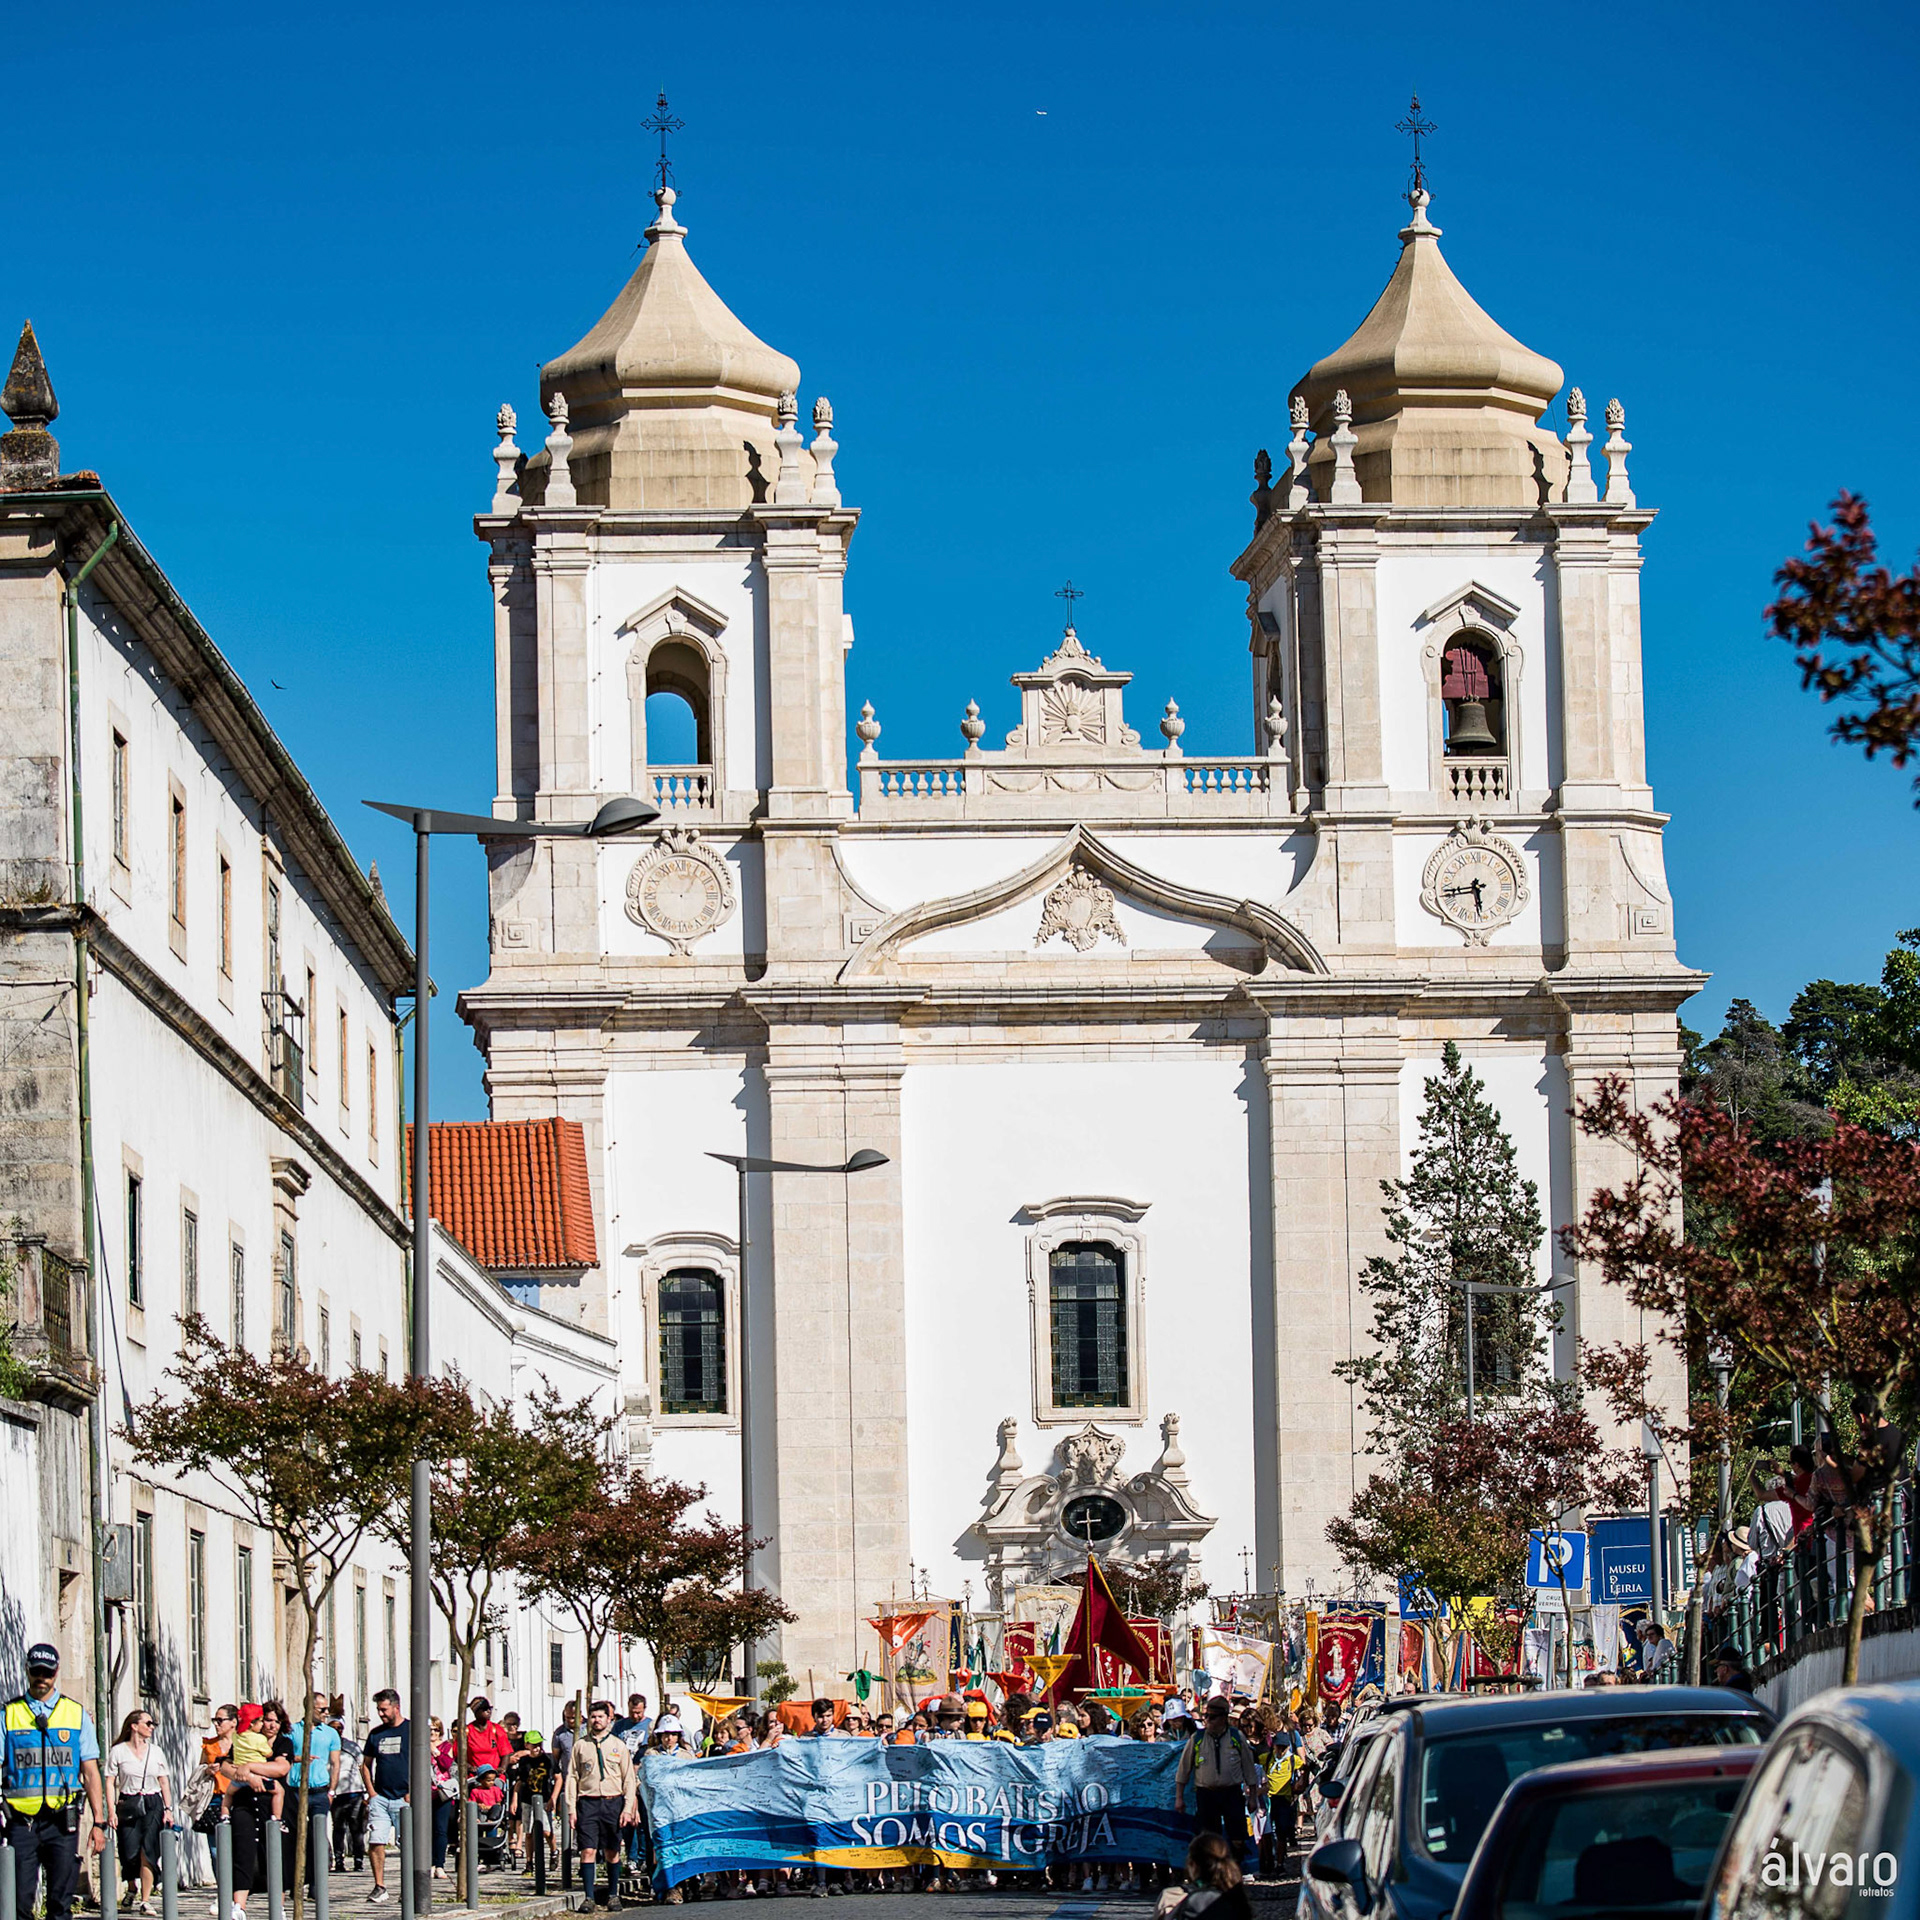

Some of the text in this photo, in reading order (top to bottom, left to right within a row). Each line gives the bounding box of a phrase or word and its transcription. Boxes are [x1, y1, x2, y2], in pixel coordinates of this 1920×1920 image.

[1538, 1536, 1573, 1583] P
[1609, 1563, 1646, 1574] MUSEU
[1610, 1583, 1643, 1594] LEIRIA
[30, 1650, 57, 1661] POLÍCIA
[16, 1747, 73, 1768] POLÍCIA
[866, 1780, 954, 1815] PELO
[851, 1813, 987, 1853] SOMOS
[1001, 1812, 1118, 1861] IGREJA
